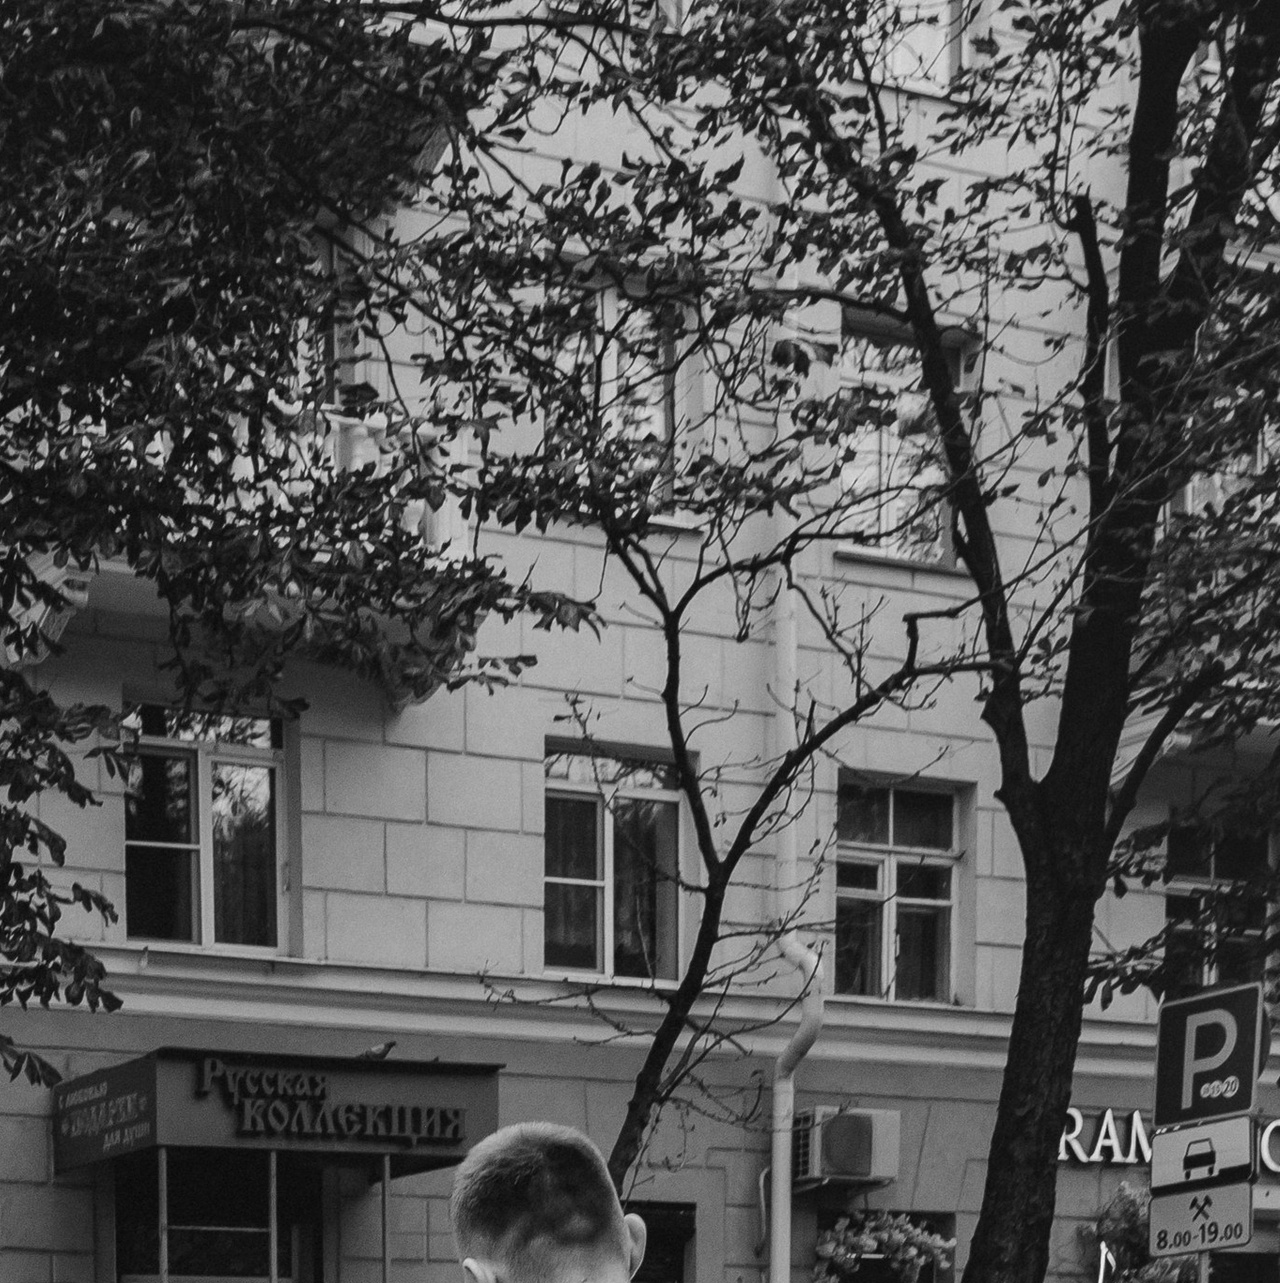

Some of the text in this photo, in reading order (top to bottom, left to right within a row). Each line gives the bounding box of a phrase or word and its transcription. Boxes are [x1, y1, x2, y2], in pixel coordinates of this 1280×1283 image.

[203, 1058, 328, 1104] Русская
[1181, 1008, 1238, 1110] P
[1156, 1221, 1243, 1250] 8.00-19.00
